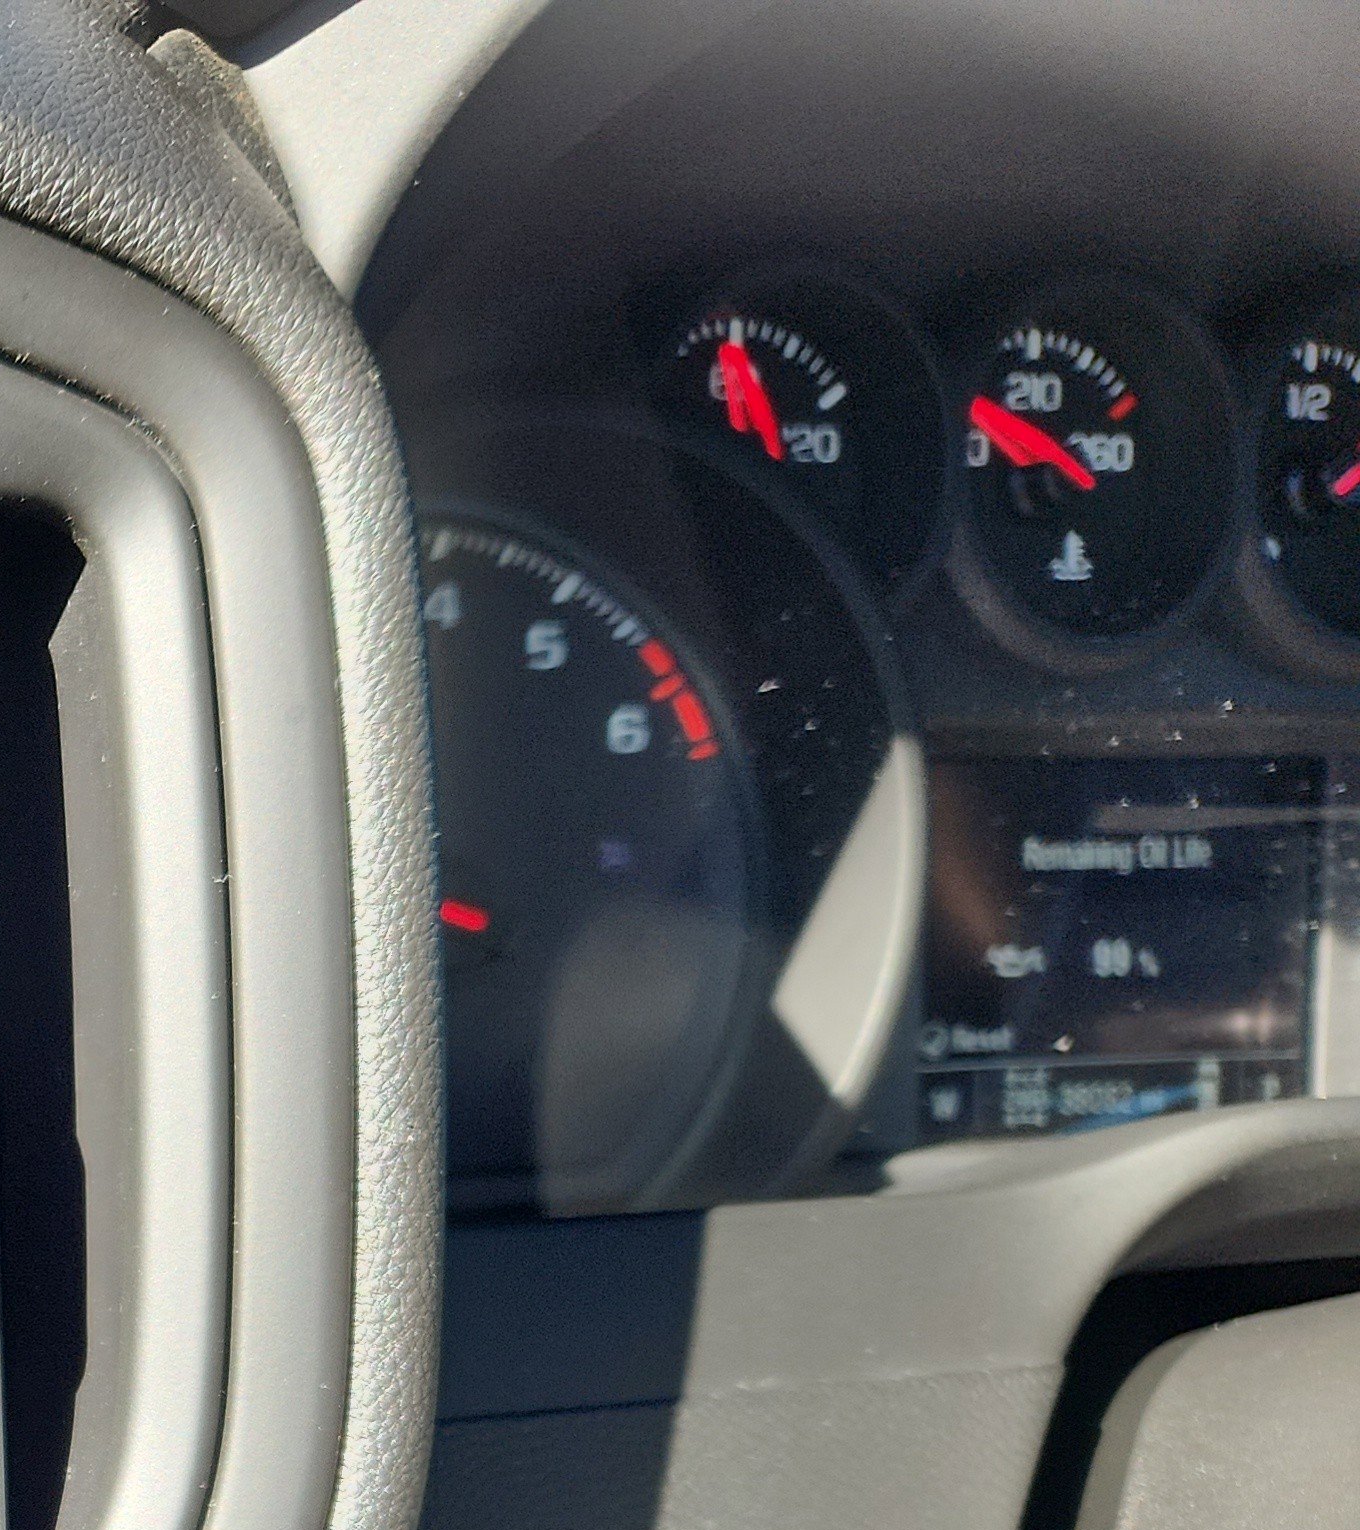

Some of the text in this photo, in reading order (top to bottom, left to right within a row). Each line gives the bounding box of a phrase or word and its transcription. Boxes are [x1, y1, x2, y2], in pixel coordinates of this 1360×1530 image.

[1004, 370, 1063, 412] 210
[424, 581, 461, 630] 4
[524, 618, 568, 671] 5
[605, 702, 650, 754] 6
